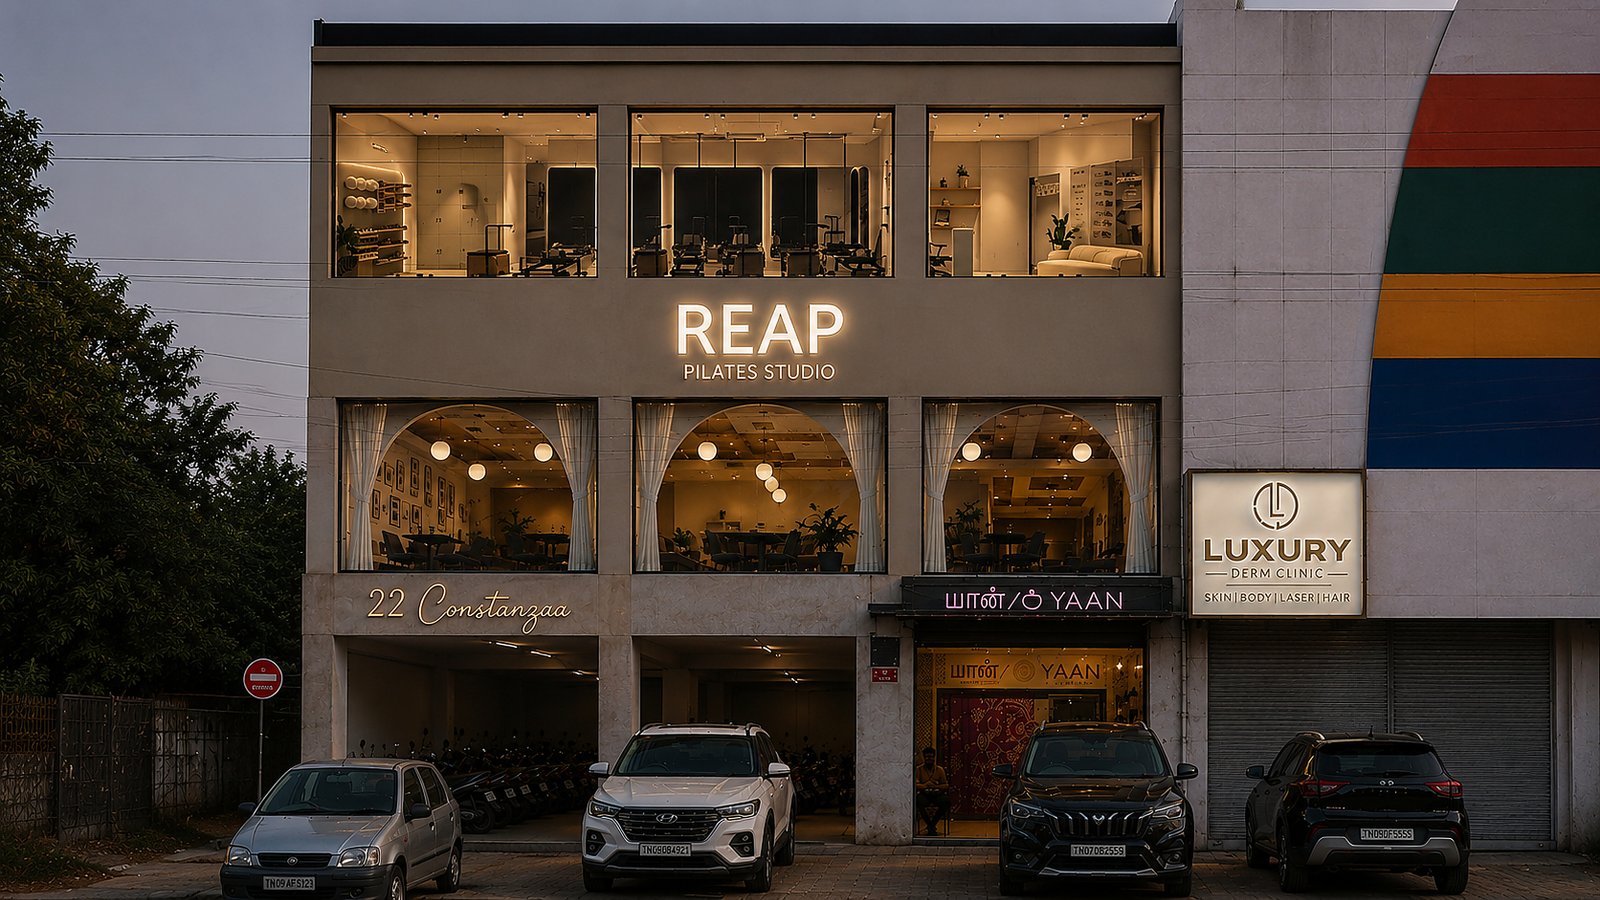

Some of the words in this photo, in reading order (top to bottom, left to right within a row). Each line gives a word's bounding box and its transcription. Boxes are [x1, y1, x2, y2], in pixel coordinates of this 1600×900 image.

[677, 304, 844, 355] REAP
[683, 363, 758, 380] PILATES
[764, 363, 836, 380] STUDIO
[1204, 539, 1352, 562] LUXURY
[1231, 568, 1271, 579] DERM
[1276, 568, 1324, 579] CLINIC
[367, 588, 406, 617] 22
[418, 583, 572, 634] Constanzaa
[1050, 591, 1123, 610] YAAN
[1041, 663, 1100, 680] YAAN
